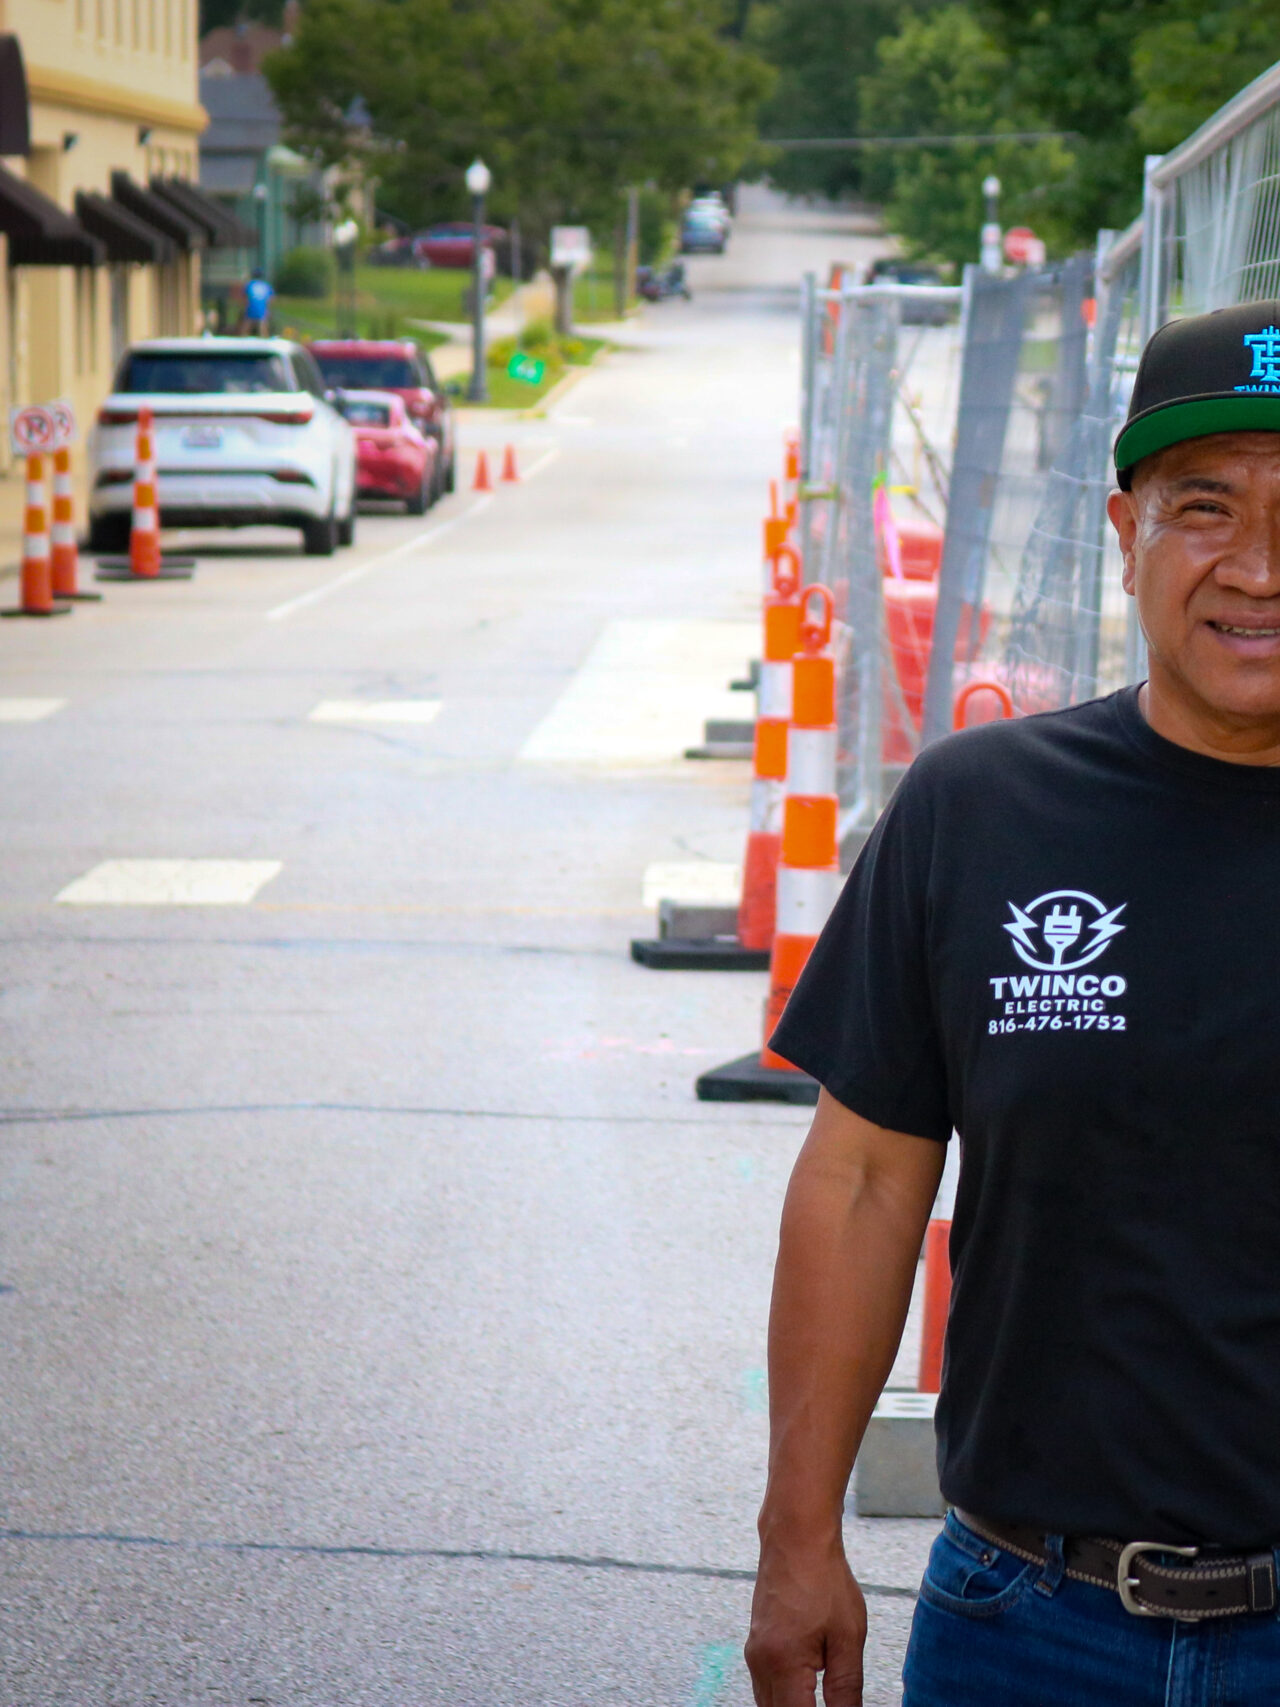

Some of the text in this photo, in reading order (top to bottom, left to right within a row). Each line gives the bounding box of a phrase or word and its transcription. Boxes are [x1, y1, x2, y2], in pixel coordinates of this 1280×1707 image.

[989, 974, 1126, 1000] TWINCO
[1004, 999, 1105, 1015] ELECTRIC
[988, 1015, 1126, 1035] 816-476-1752
